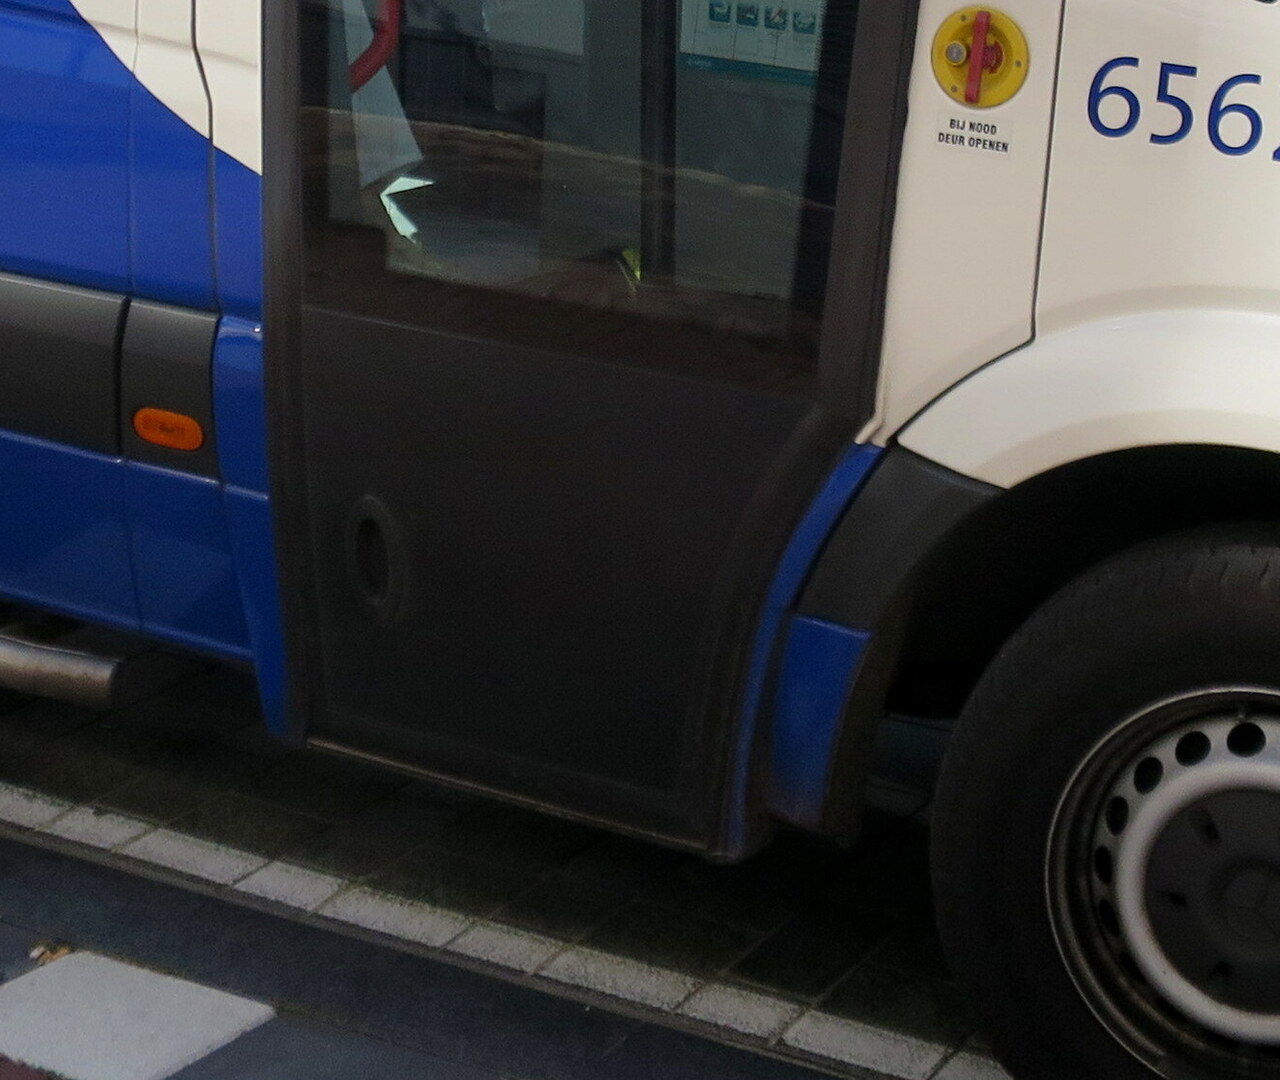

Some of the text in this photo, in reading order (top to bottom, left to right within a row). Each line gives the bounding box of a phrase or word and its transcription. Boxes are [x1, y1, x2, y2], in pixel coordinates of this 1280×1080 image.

[949, 119, 998, 135] BIJ NOOD
[938, 132, 1009, 153] DEUR OPENEN
